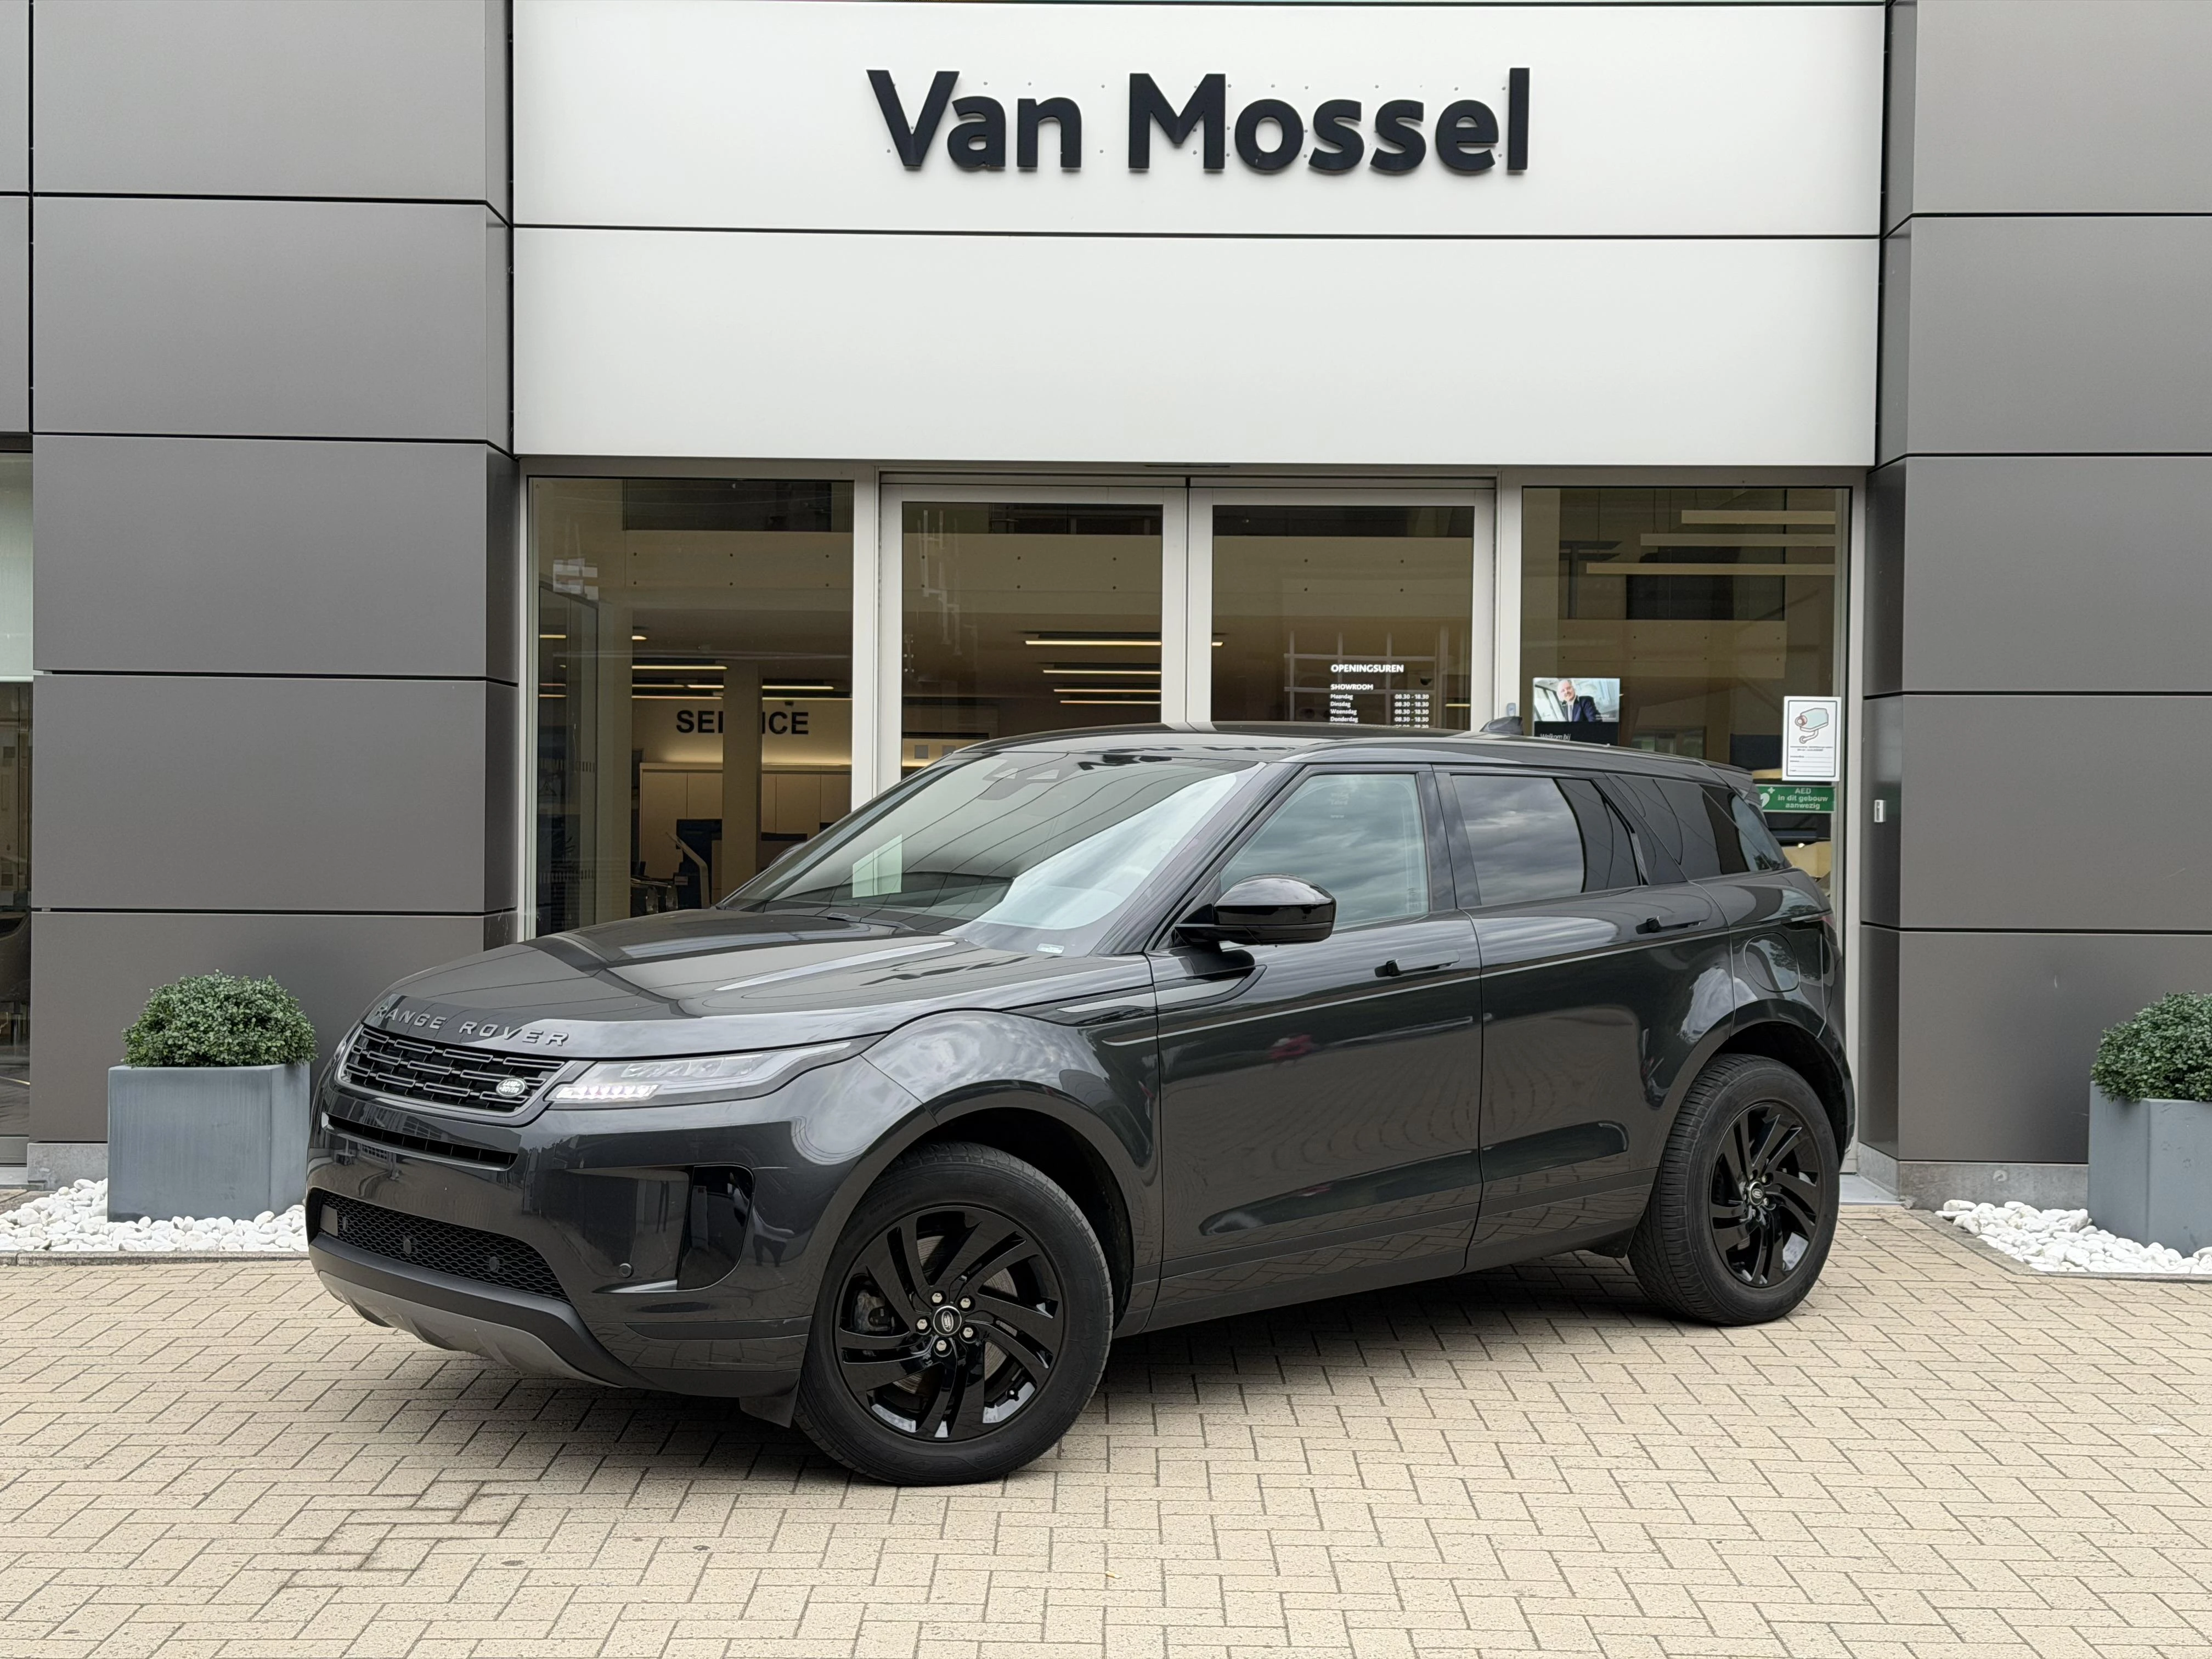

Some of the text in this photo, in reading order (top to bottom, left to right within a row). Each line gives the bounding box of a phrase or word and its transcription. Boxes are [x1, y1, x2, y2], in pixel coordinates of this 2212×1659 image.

[866, 67, 1530, 172] Van Mossel
[1330, 664, 1404, 673] OPENINGSUREN
[676, 710, 809, 735] SEICE
[375, 1006, 569, 1047] RANGE ROVER
